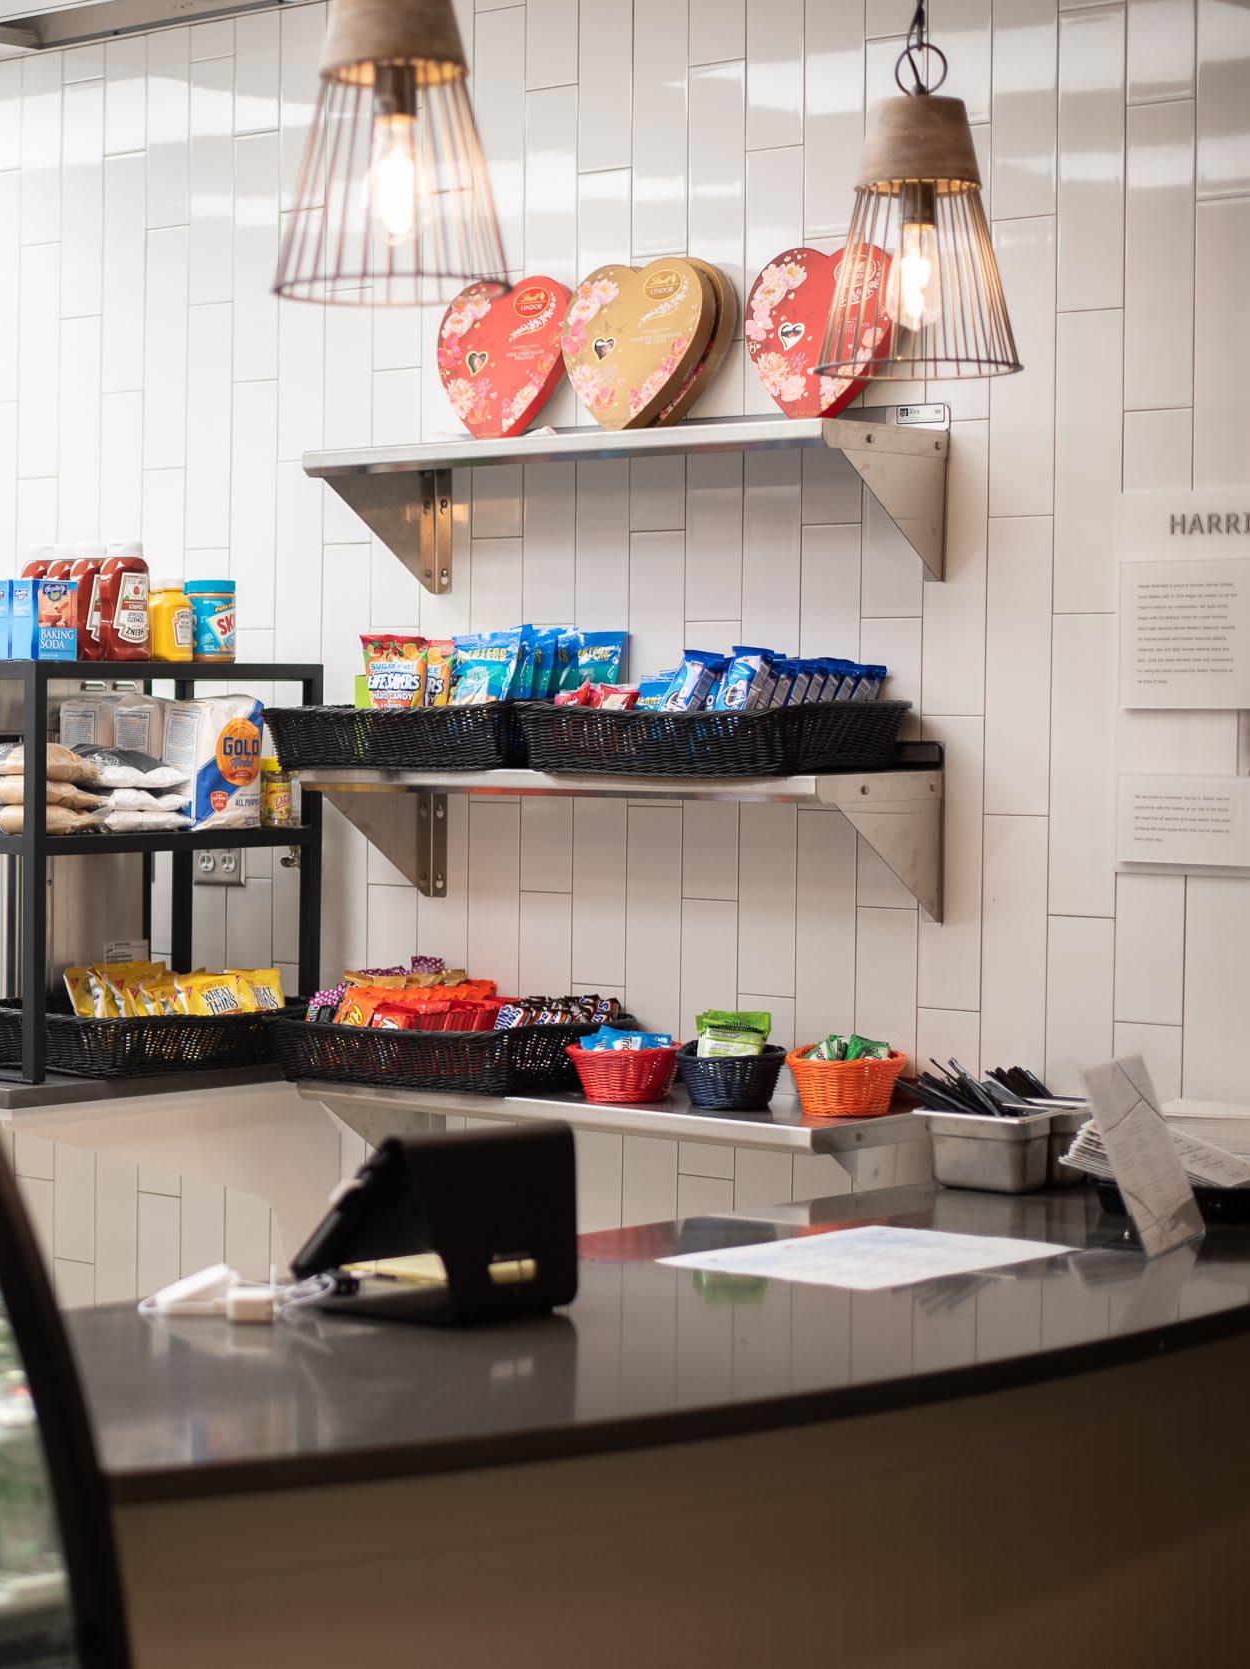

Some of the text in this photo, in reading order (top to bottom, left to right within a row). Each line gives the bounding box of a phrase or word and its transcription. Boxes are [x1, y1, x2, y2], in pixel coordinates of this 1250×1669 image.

[651, 287, 673, 295] LINDOR
[40, 629, 74, 640] BAKING
[125, 627, 144, 636] HEINZ
[40, 640, 65, 649] SODA
[372, 692, 414, 700] HARD CANDY
[223, 736, 259, 756] GOLD
[202, 986, 232, 1002] WHEAT
[207, 995, 239, 1015] THINS
